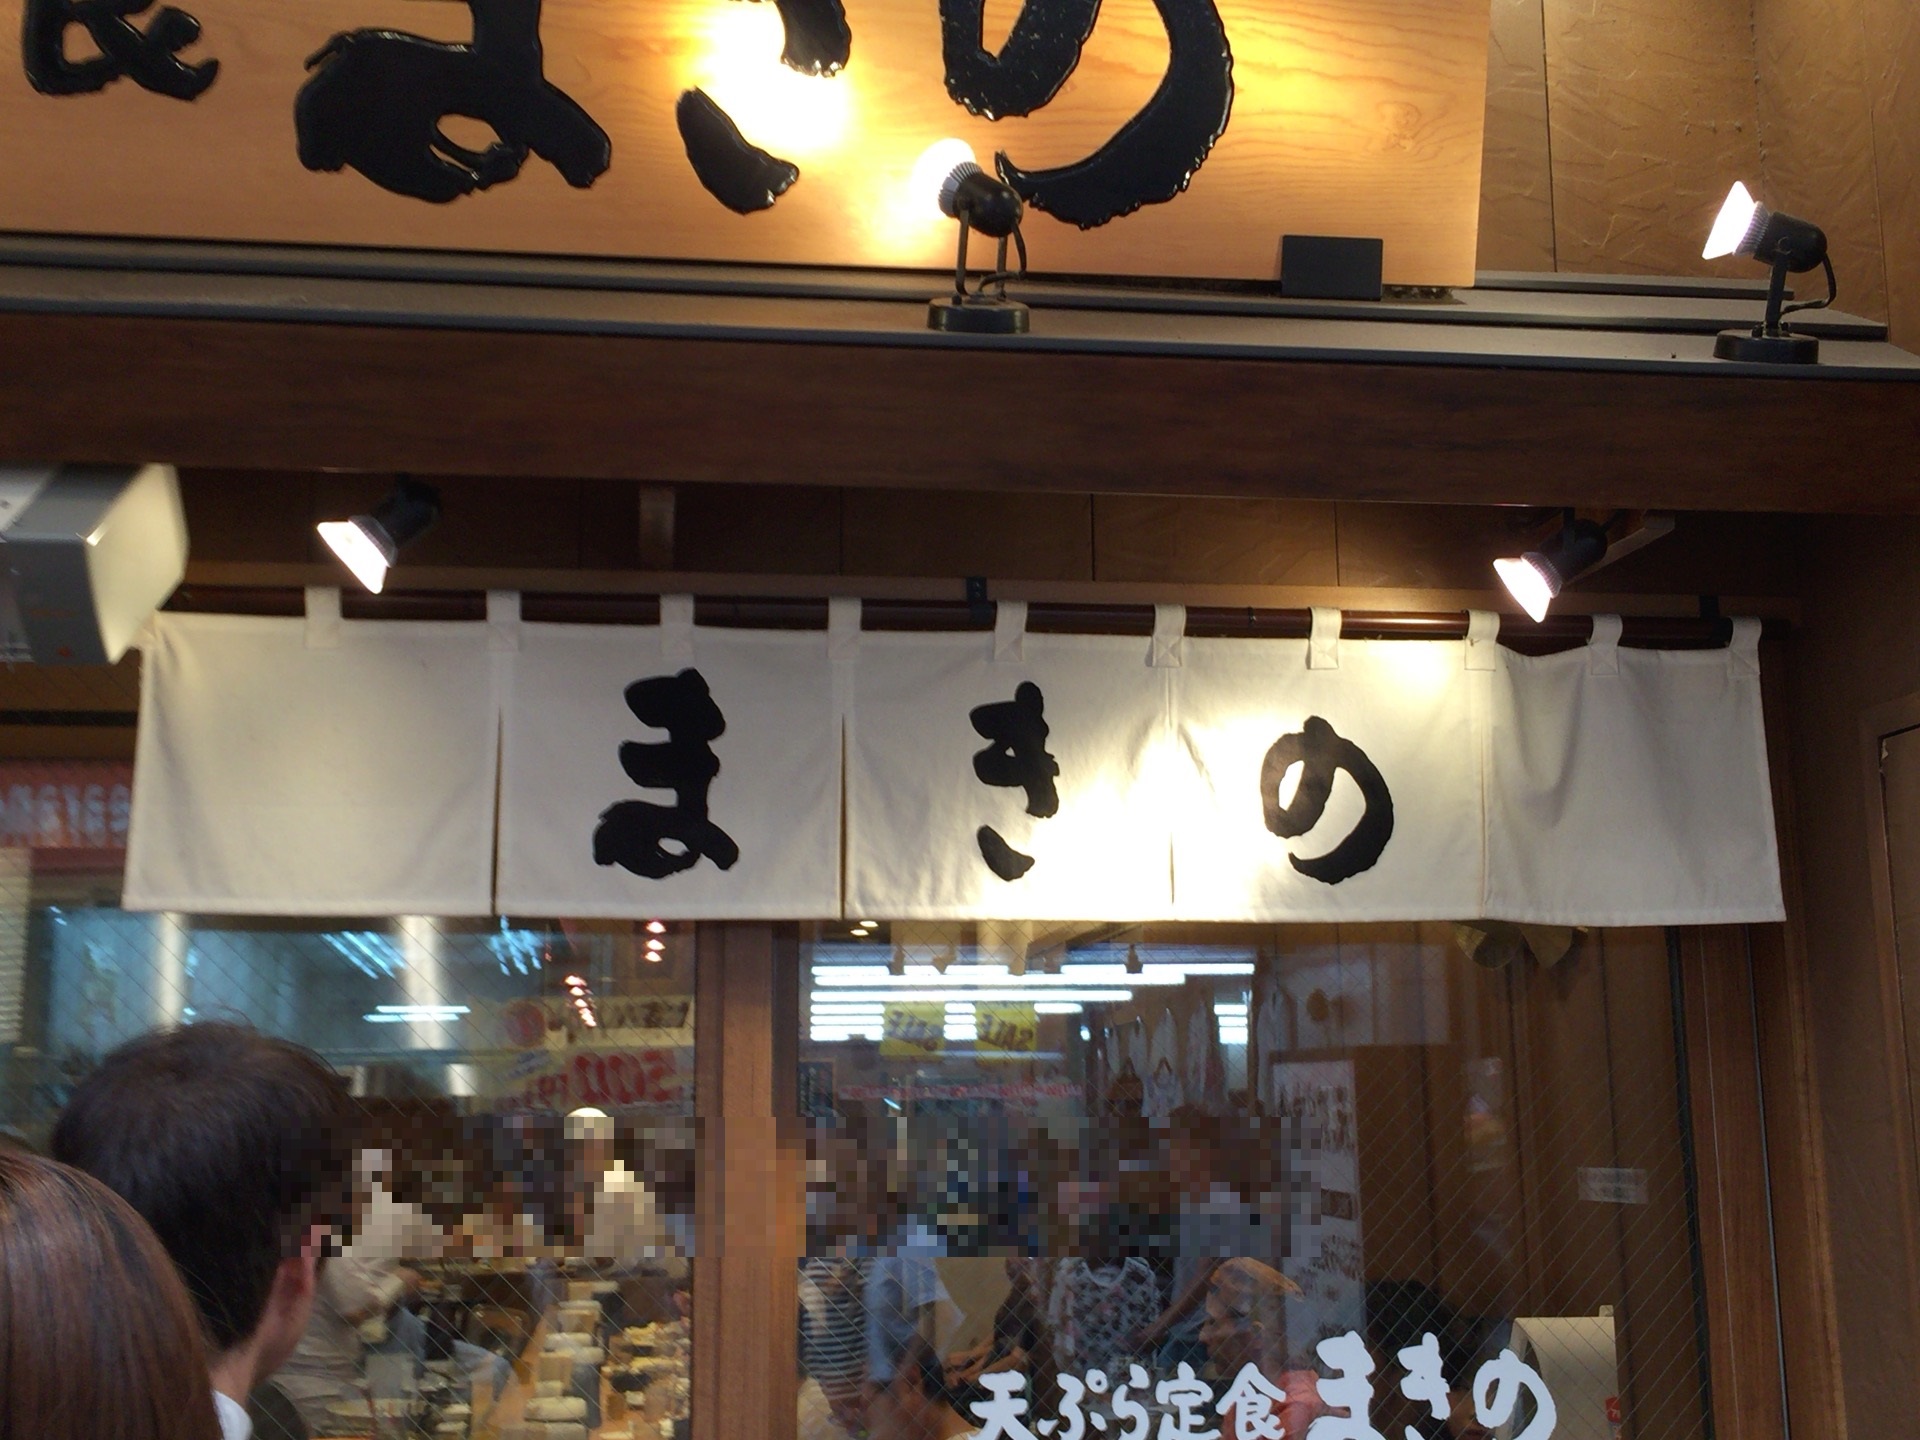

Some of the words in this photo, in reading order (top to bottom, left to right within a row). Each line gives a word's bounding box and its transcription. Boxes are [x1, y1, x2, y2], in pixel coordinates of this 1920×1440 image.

[593, 667, 1395, 886] まきの
[968, 1361, 1286, 1440] 天ぷら定食
[1302, 1330, 1557, 1440] まきの
